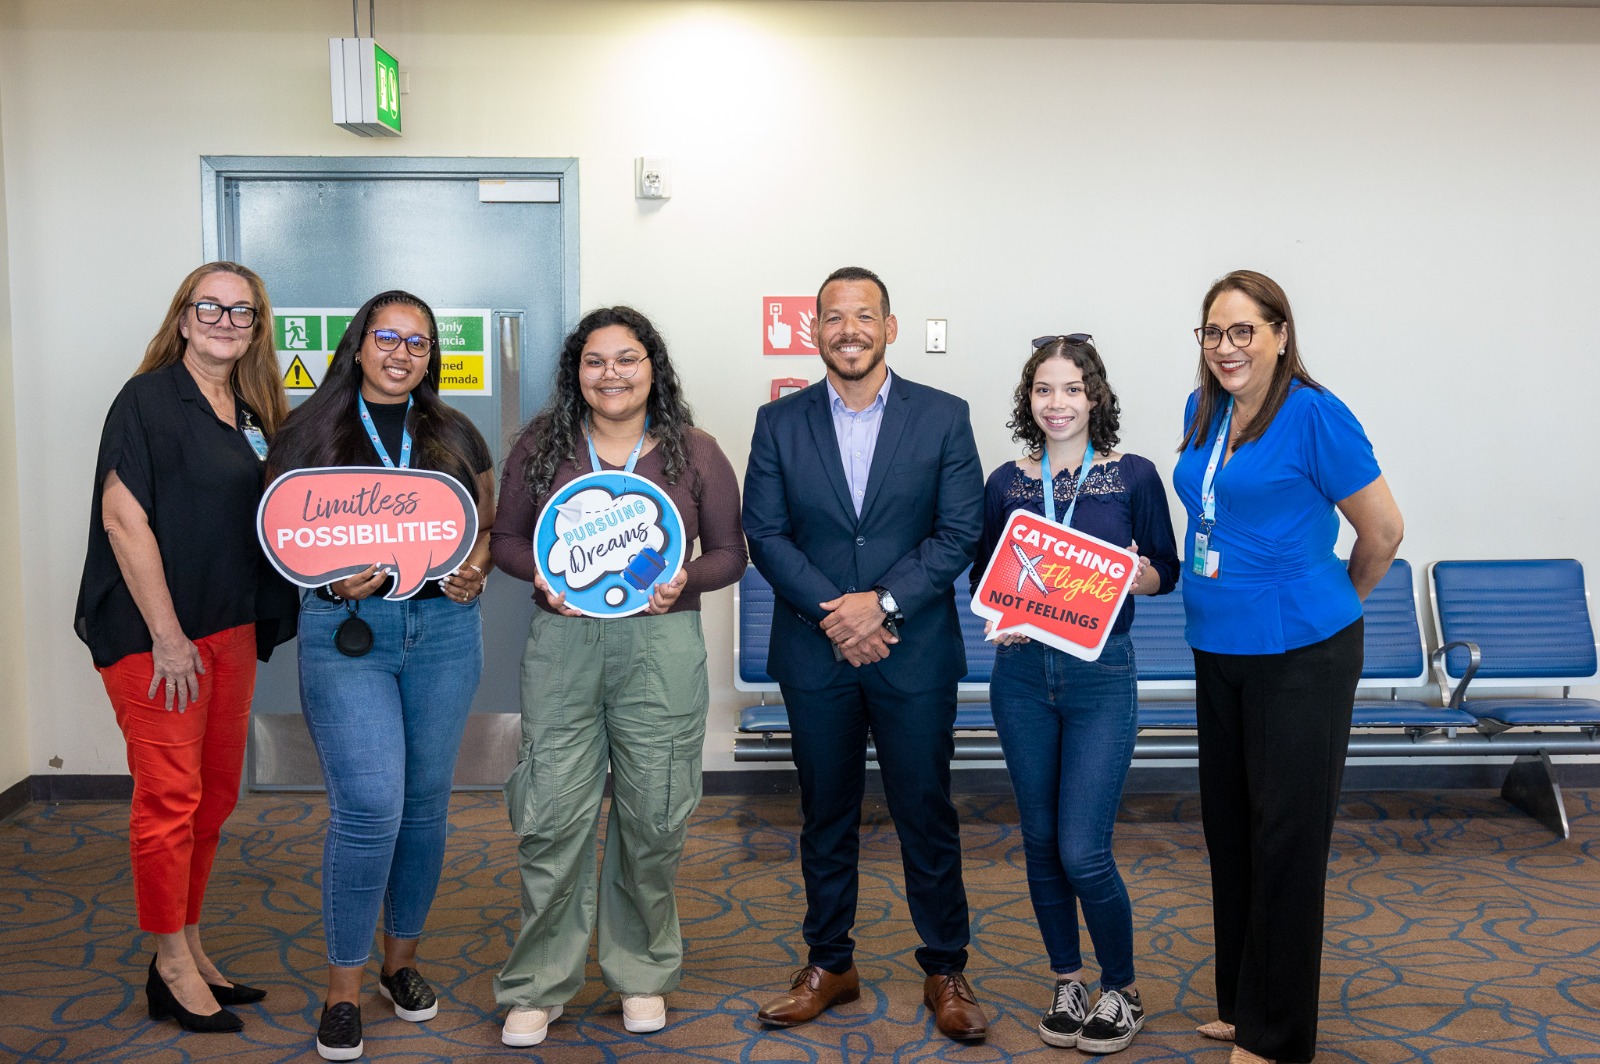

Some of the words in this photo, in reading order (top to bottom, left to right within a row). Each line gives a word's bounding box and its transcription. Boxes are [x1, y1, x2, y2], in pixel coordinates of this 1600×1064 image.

[438, 322, 462, 334] Only
[302, 481, 421, 522] Limitless
[277, 520, 458, 549] POSSIBILITIES
[563, 499, 646, 546] PURSUING
[570, 522, 649, 573] Dreams
[1012, 524, 1126, 579] CATCHING
[1041, 563, 1119, 603] Flights
[988, 590, 1025, 610] NOT
[1025, 600, 1100, 630] FEELINGS
